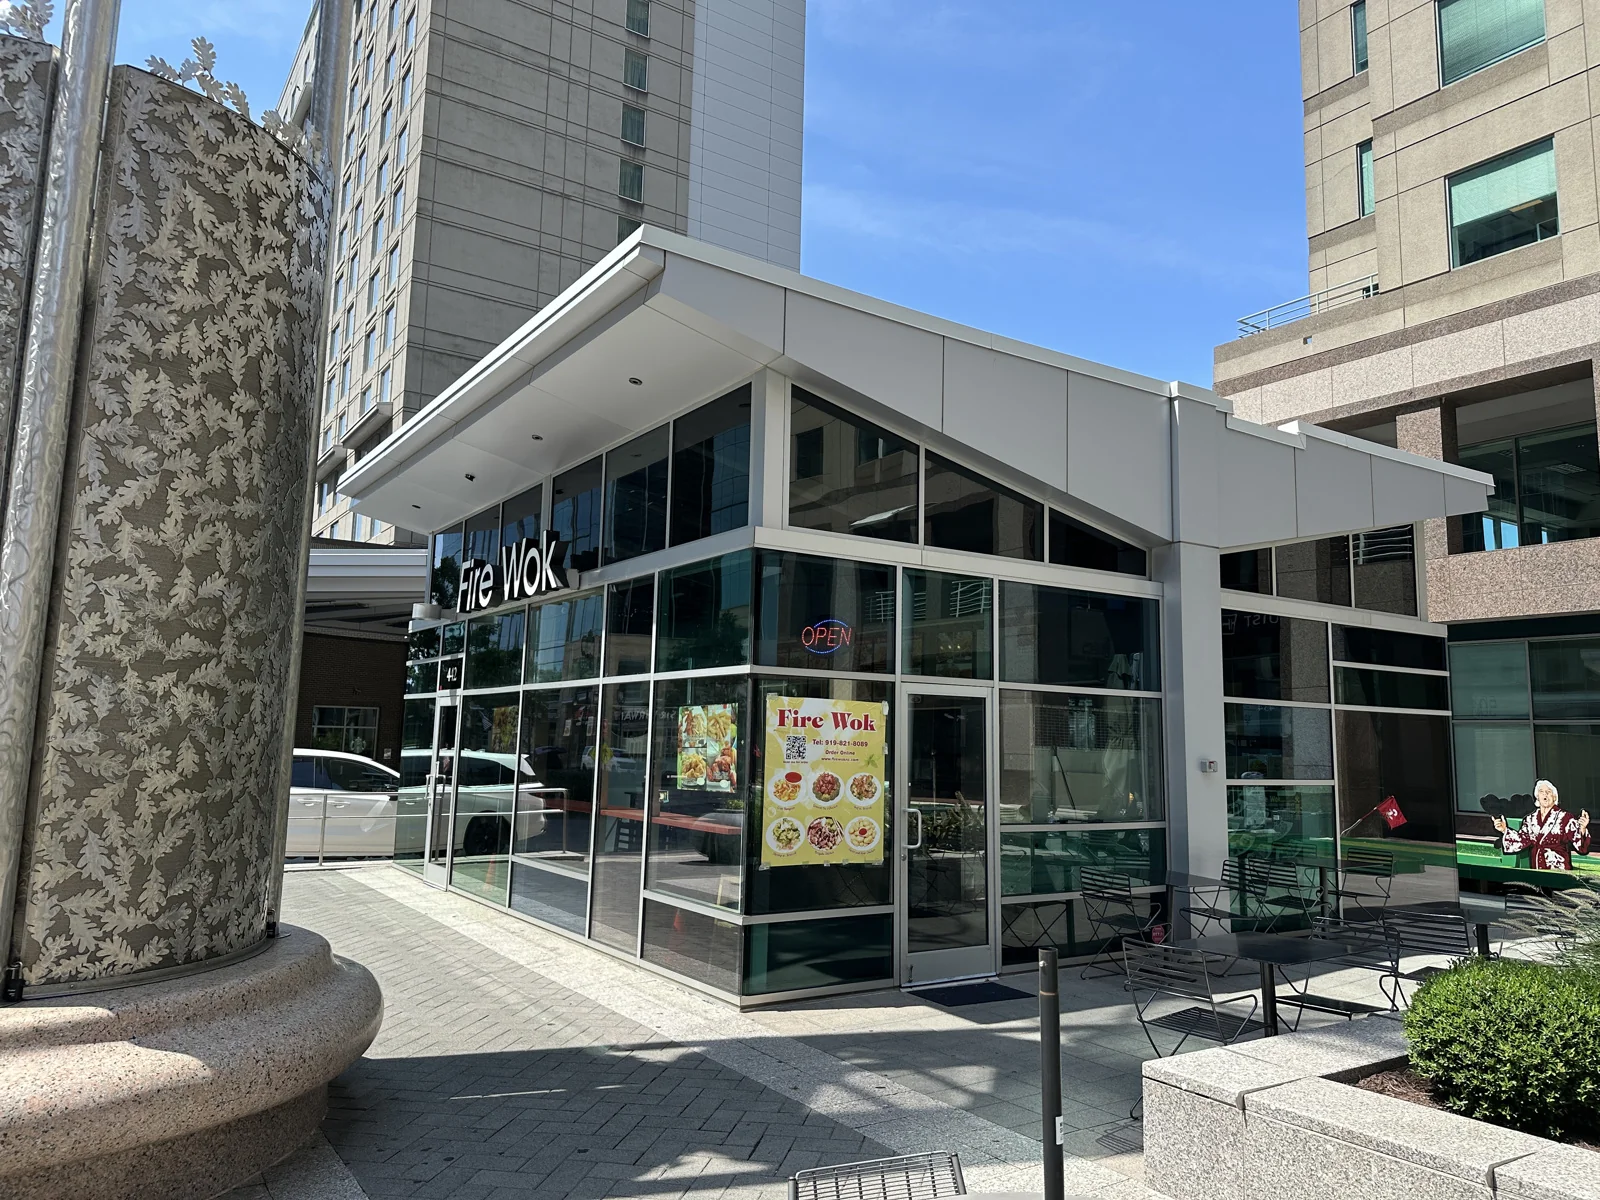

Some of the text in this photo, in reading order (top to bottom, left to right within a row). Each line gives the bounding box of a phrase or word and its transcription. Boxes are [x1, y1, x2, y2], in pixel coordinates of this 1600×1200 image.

[456, 530, 558, 613] Fire Wok
[801, 626, 852, 646] OPEN
[446, 666, 458, 682] 442
[777, 708, 876, 732] Fire Wok
[812, 738, 869, 747] Tel: 919-821-8089
